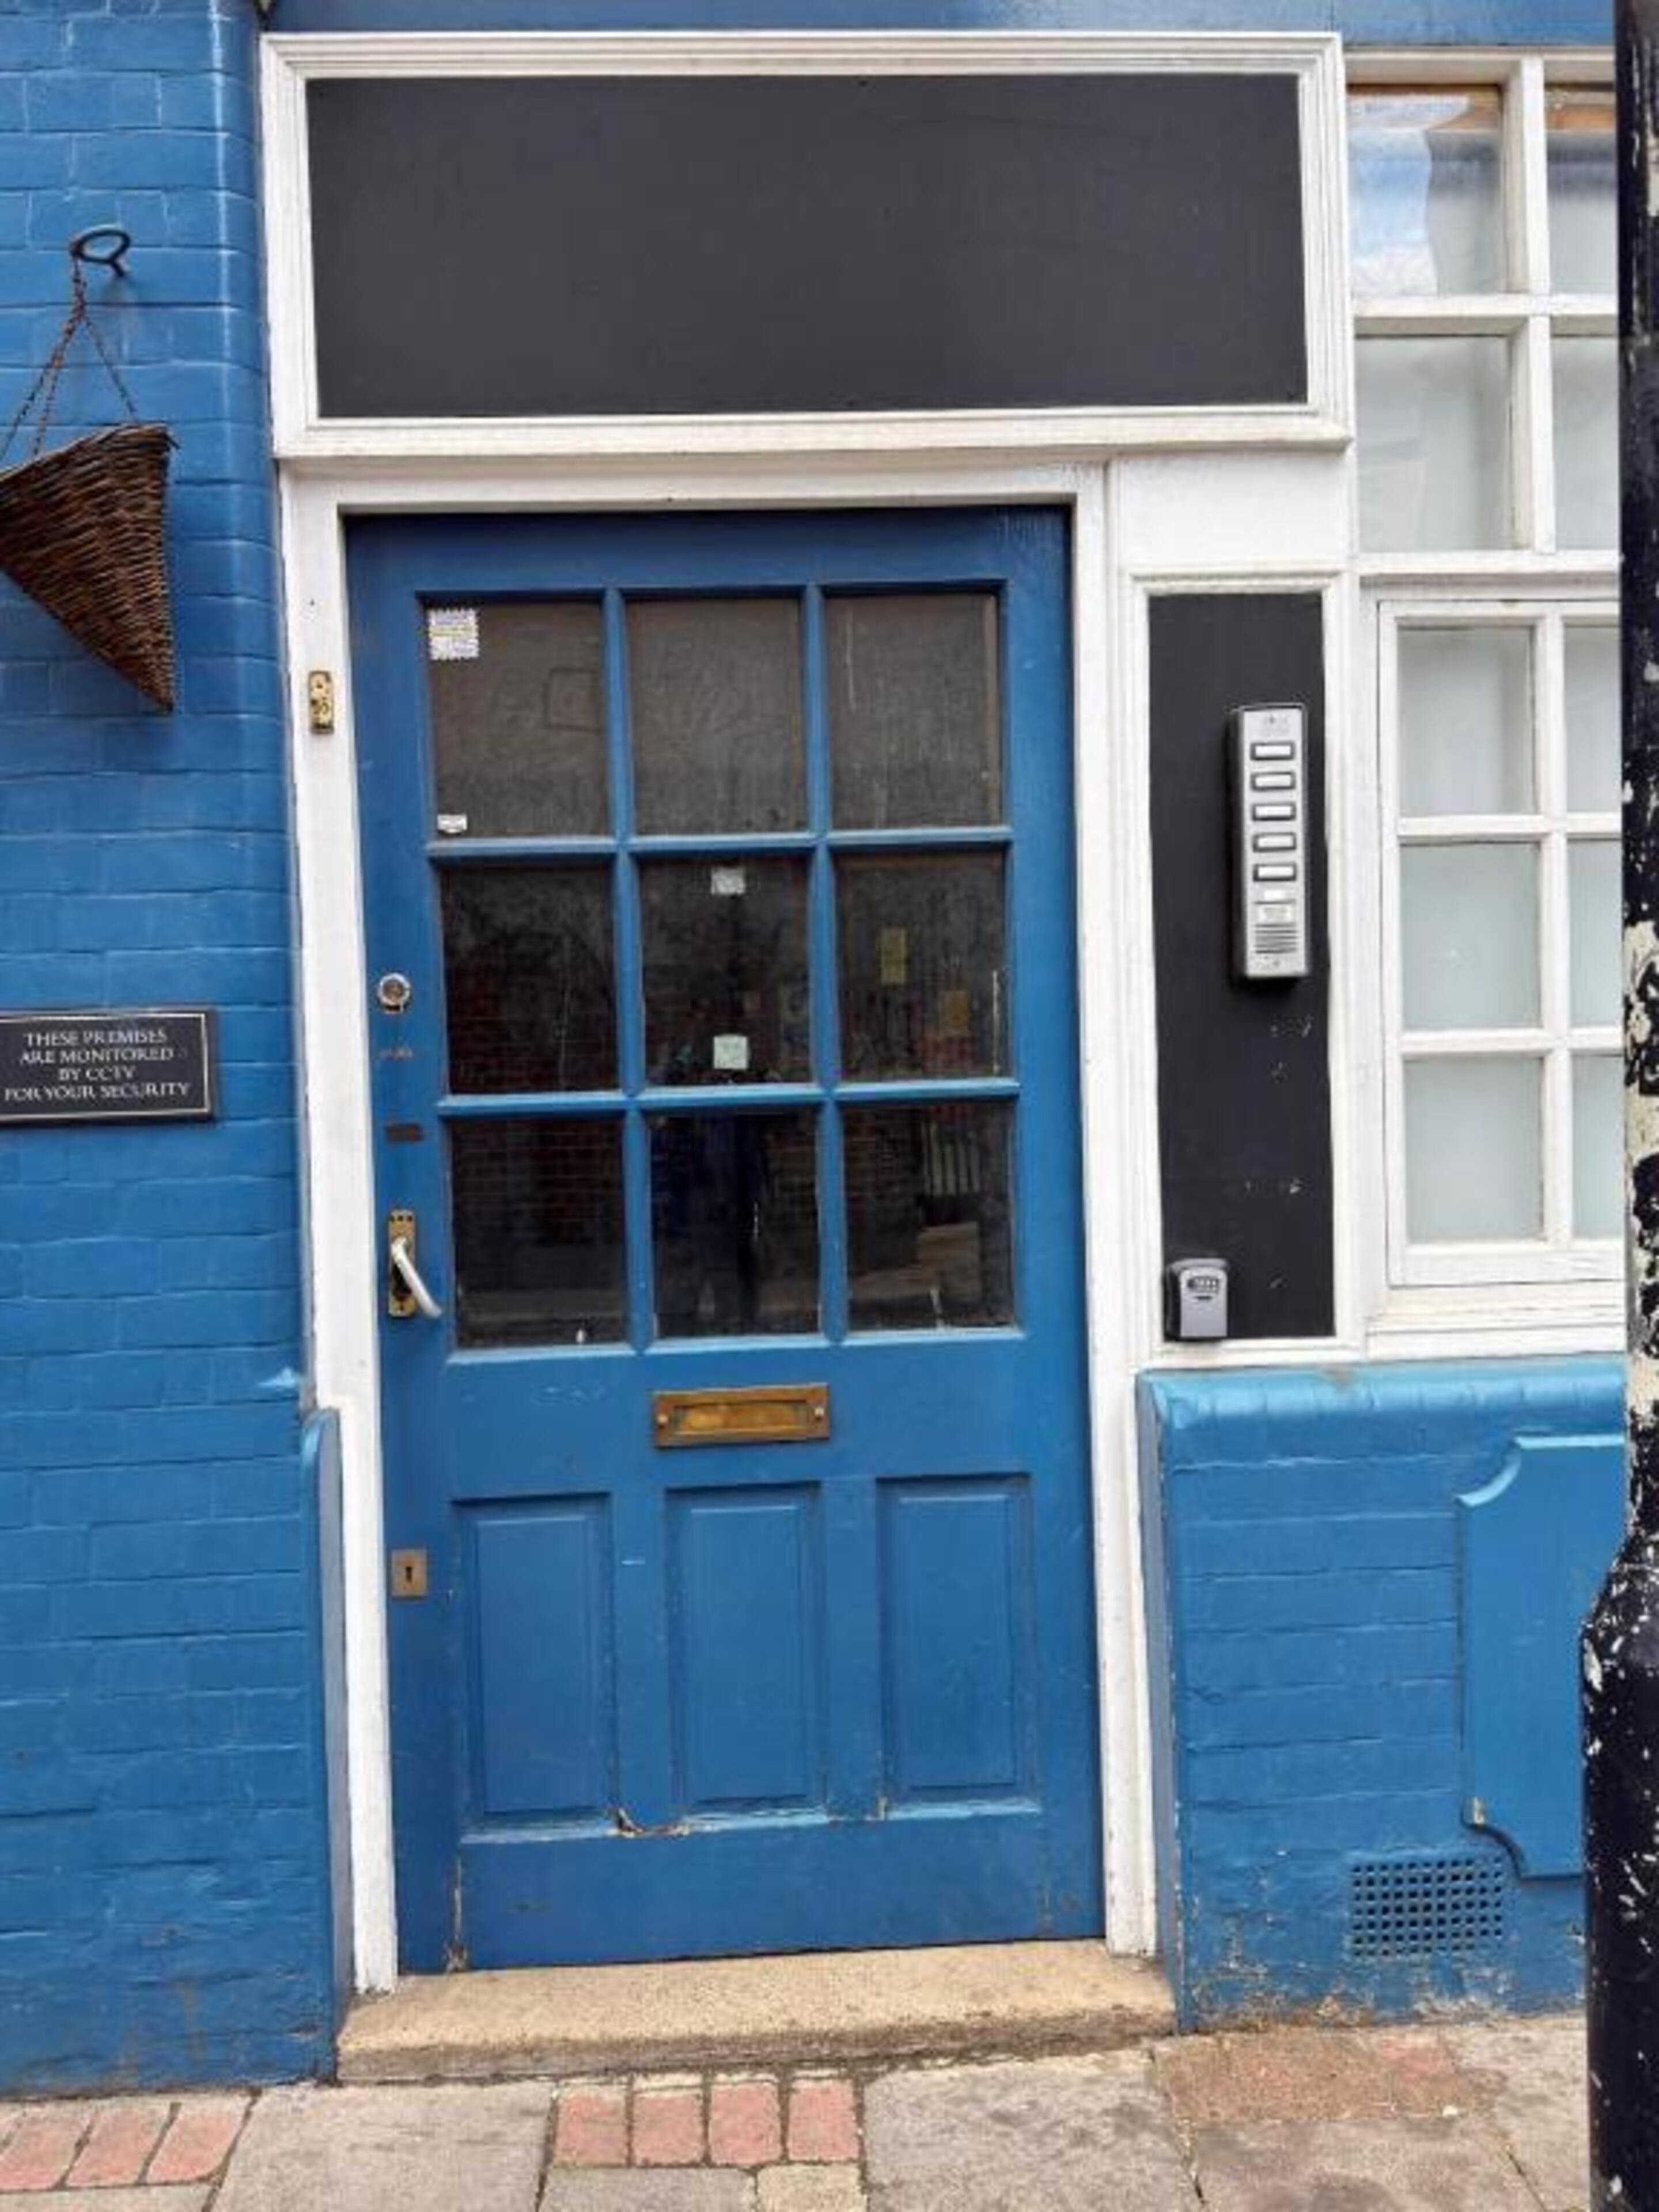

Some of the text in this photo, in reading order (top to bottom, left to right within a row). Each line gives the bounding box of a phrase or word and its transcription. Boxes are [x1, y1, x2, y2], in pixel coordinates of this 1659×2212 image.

[24, 1028, 168, 1047] THESE PREMISES
[20, 1048, 173, 1065] ARE MONITORED
[59, 1065, 137, 1081] BY CCTV
[5, 1082, 190, 1101] FOR YOUR SECURITY
